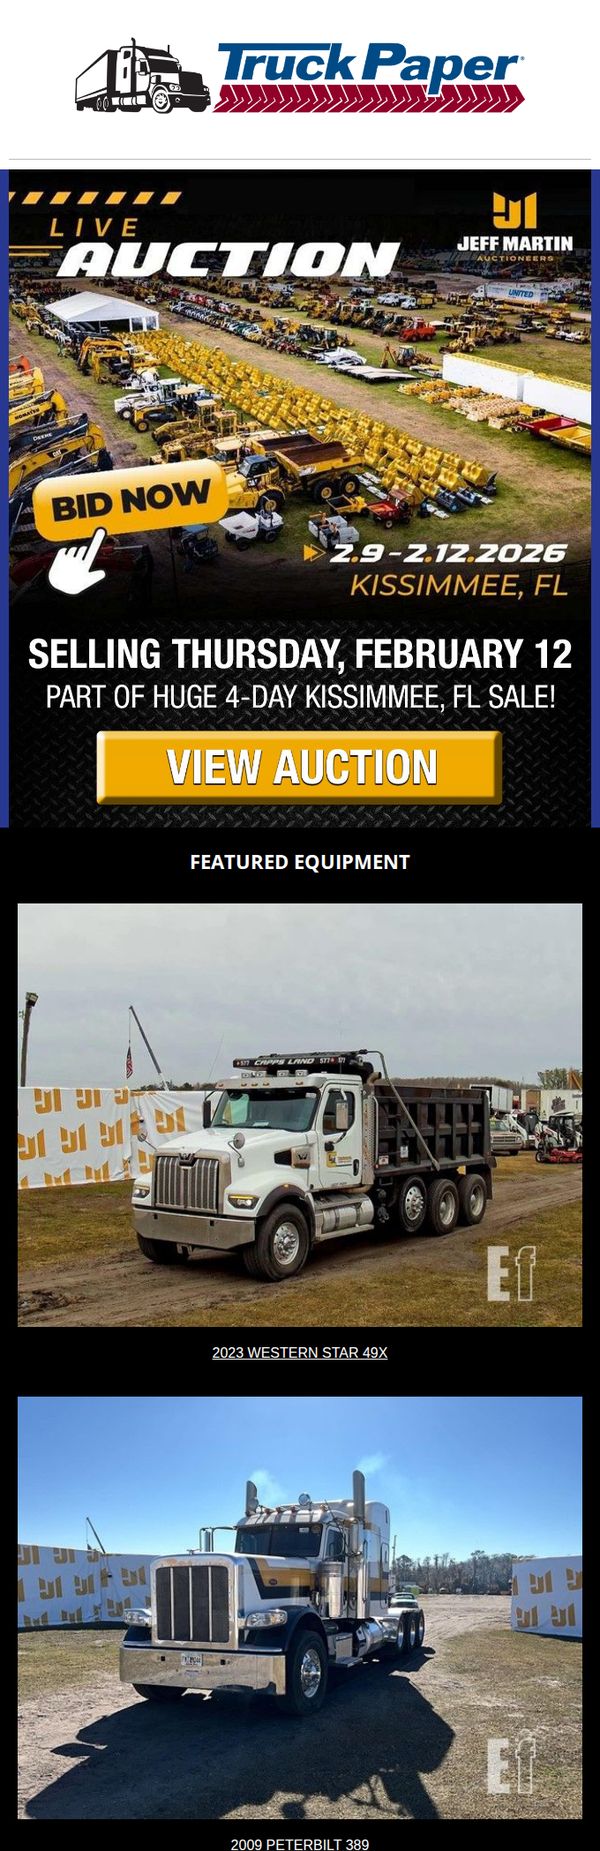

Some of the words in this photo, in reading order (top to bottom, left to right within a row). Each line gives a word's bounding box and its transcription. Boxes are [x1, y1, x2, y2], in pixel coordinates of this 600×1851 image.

[218, 43, 355, 80] Truck
[362, 43, 519, 95] Paper
[51, 218, 138, 236] LIVE
[458, 237, 498, 250] JEFF
[503, 237, 572, 250] MARTIN
[57, 243, 400, 277] AUCTION
[508, 289, 534, 298] UNITED
[52, 492, 113, 522] BID
[120, 479, 211, 513] NOW
[351, 575, 522, 599] KISSIMMEE,
[535, 575, 567, 595] FL
[29, 638, 160, 669] SELLING
[172, 638, 344, 675] THURSDAY,
[356, 639, 523, 669] FEBRUARY
[536, 639, 571, 668] 12
[47, 685, 106, 708] PART
[115, 685, 144, 708] OF
[154, 684, 216, 708] HUGE
[226, 685, 297, 708] 4-DAY
[306, 684, 444, 712] KISSIMMEE,
[454, 685, 480, 708] FL
[489, 685, 554, 708] SALE!
[167, 749, 261, 783] VIEW
[274, 749, 436, 784] AUCTION
[191, 855, 288, 869] FEATURED
[295, 855, 410, 873] EQUIPMENT
